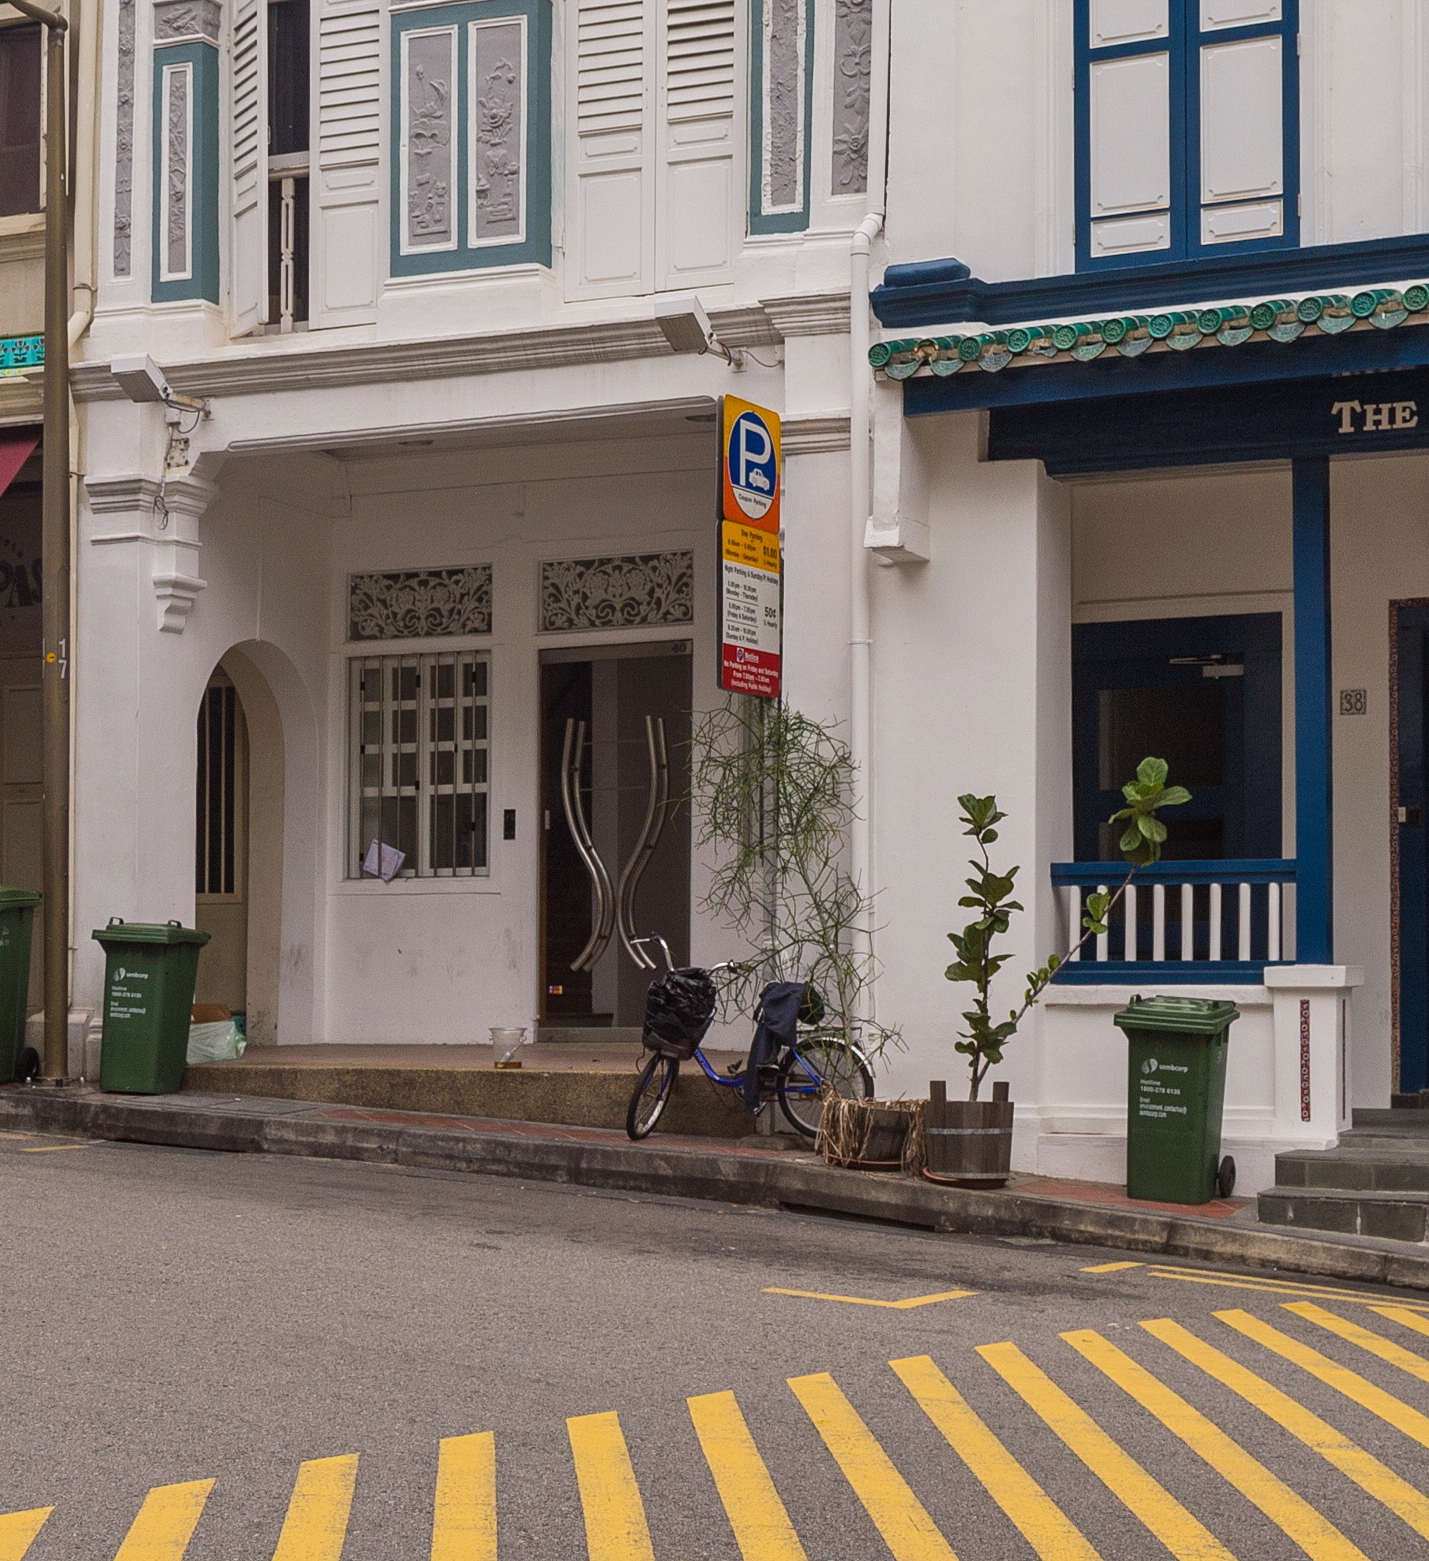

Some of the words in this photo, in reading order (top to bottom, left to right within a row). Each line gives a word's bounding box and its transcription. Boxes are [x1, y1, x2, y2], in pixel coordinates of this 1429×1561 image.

[1331, 399, 1419, 434] THE
[739, 419, 772, 487] P
[738, 492, 752, 503] Coupon
[753, 498, 767, 509] Parking
[734, 566, 747, 578] Parking
[1344, 692, 1363, 712] 38
